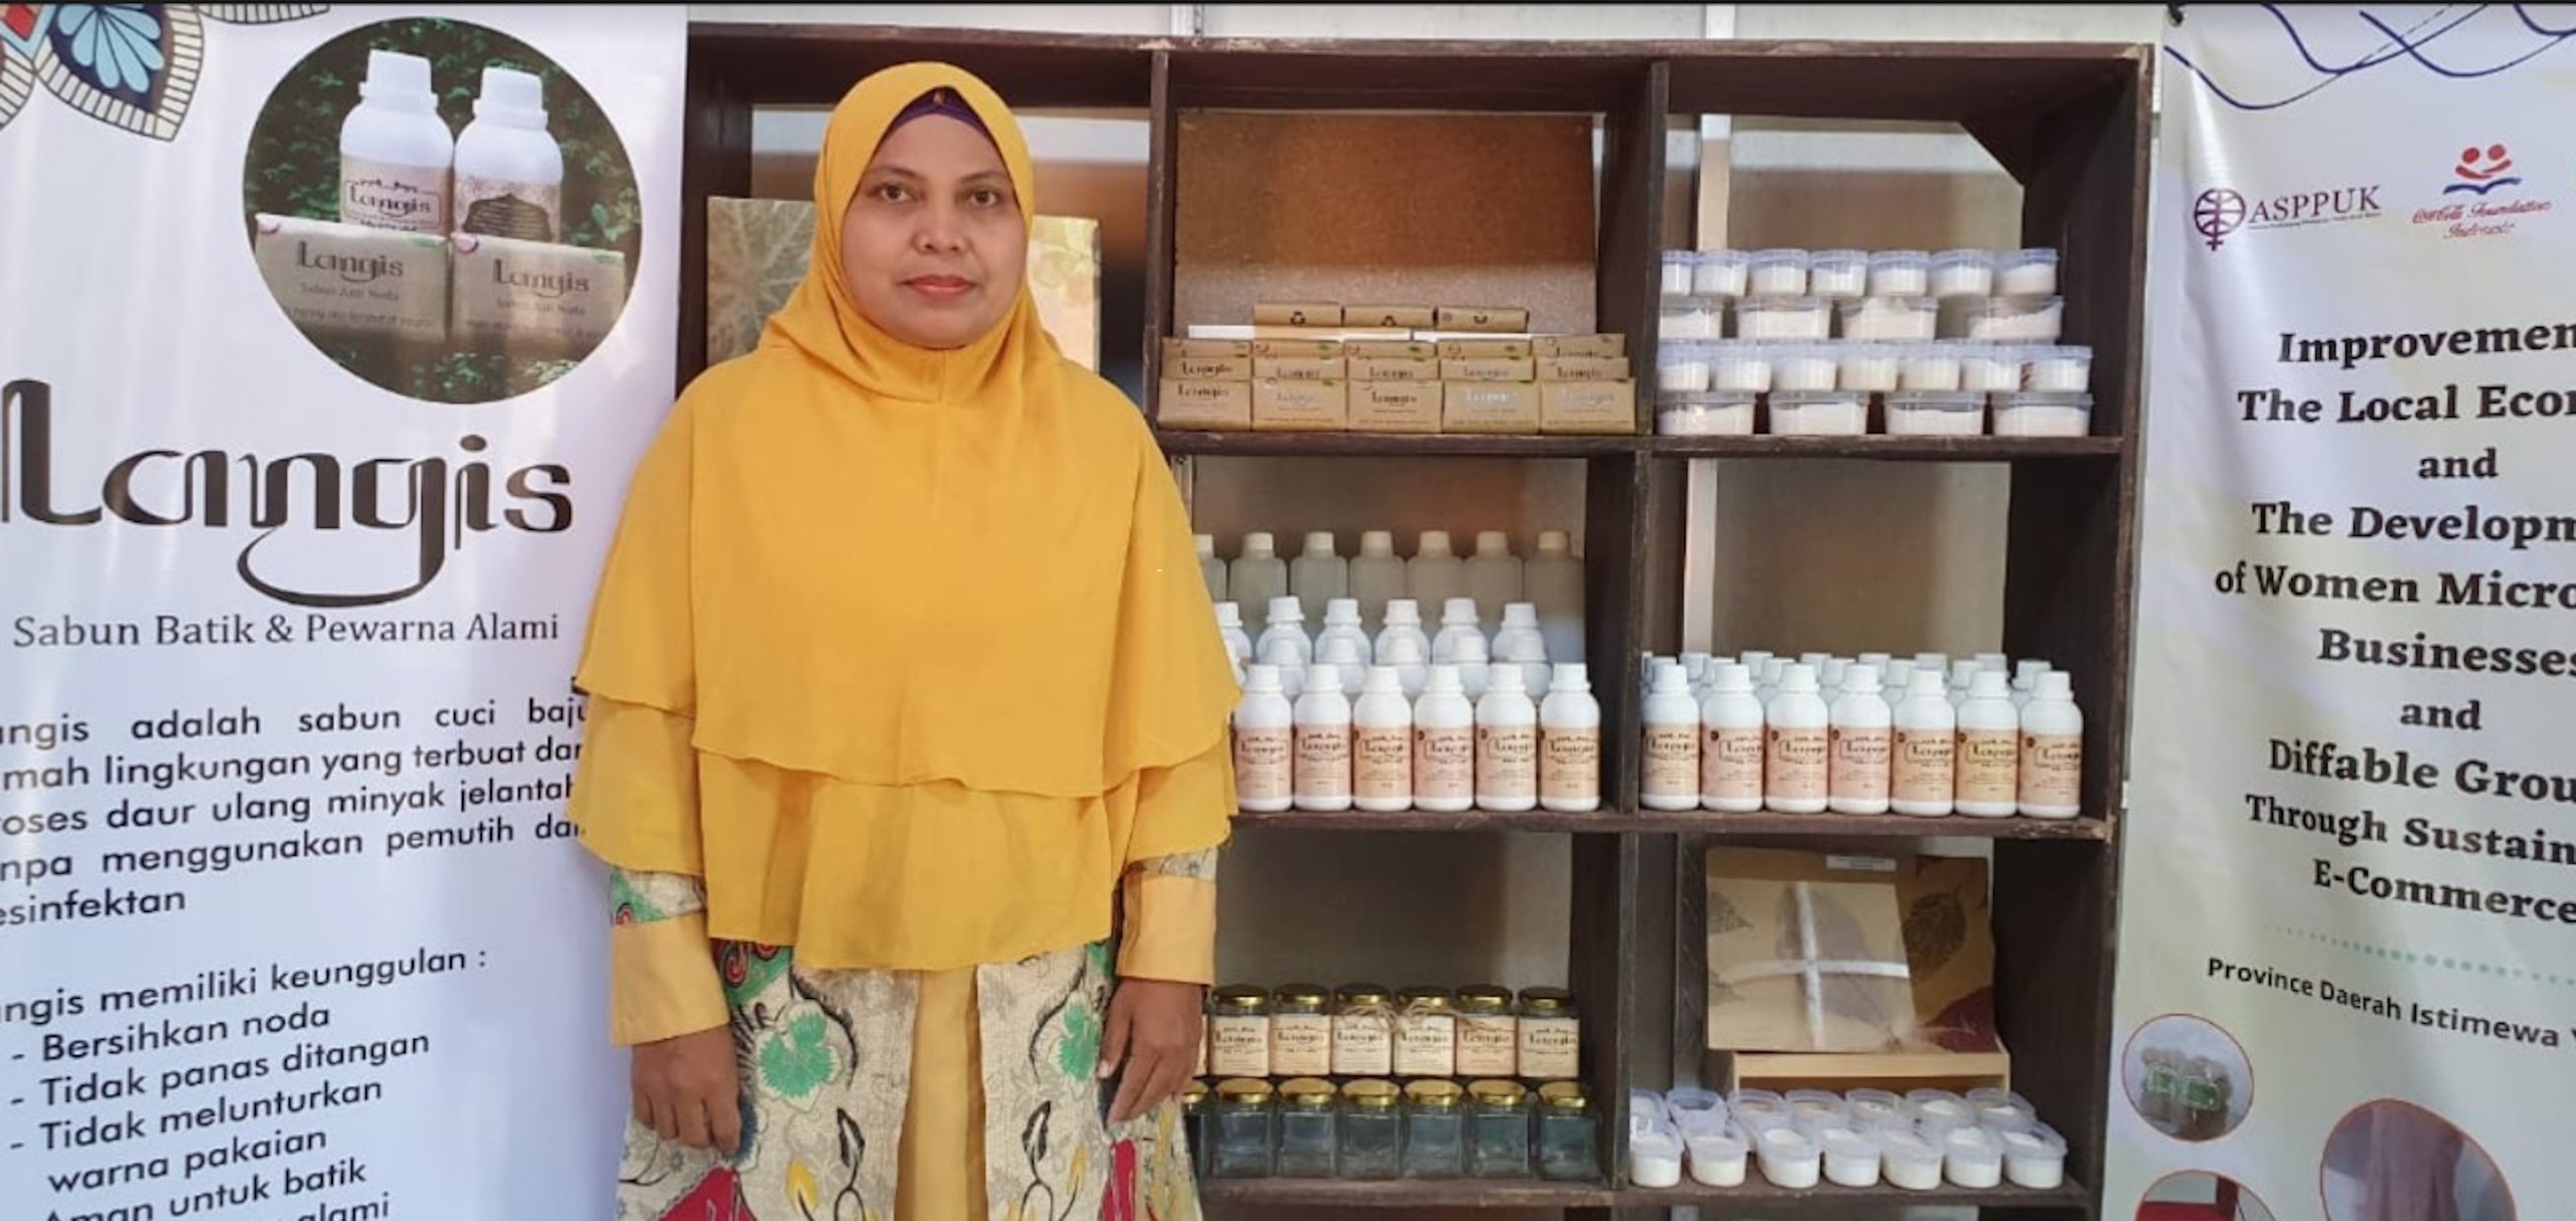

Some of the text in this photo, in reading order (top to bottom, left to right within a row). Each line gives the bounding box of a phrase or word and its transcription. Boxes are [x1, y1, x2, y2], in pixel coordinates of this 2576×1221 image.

[2249, 185, 2380, 222] ASPPUK
[297, 240, 403, 282] Langis
[493, 258, 589, 298] Langis
[2237, 388, 2323, 424] The
[2336, 383, 2460, 423] Local
[1, 378, 573, 607] Langis
[2417, 447, 2499, 480] and
[2251, 501, 2333, 536] The
[2215, 559, 2576, 609] of Women Micro
[14, 612, 558, 647] Sabun Batik & Pewarna Alami
[0, 713, 89, 750] ngis
[131, 706, 261, 740] adalah
[298, 702, 401, 733] sabun
[435, 699, 495, 728] cuci
[2400, 699, 2482, 731] and
[3, 756, 89, 791] mah
[105, 751, 310, 790] lingkungan
[321, 751, 402, 781] yang
[413, 738, 526, 768] terbuat
[2269, 738, 2576, 804] Diffable Grou
[0, 810, 88, 836] oses
[106, 798, 196, 829] daur
[212, 791, 310, 823] ulang
[327, 780, 445, 817] minyak
[2245, 793, 2576, 865] Through Sustain
[0, 856, 73, 887] npa
[102, 828, 363, 873] menggunakan
[387, 816, 514, 857] pemutih
[2313, 859, 2576, 925] E-Commerce
[0, 988, 84, 1027] ngis
[100, 967, 256, 1013] memiliki
[271, 947, 465, 991] keunggulan
[2208, 957, 2559, 1047] Province Daerah Istimewa
[42, 1019, 228, 1062] Bersihkan
[243, 1000, 330, 1036] noda
[39, 1066, 146, 1106] Tidak
[161, 1058, 270, 1099] panas
[282, 1035, 429, 1073] ditangan
[39, 1110, 146, 1150] Tidak
[160, 1075, 381, 1135] melunturkan
[48, 1129, 326, 1193] warna pakaian
[169, 1173, 270, 1217] untuk
[283, 1157, 366, 1196] batik
